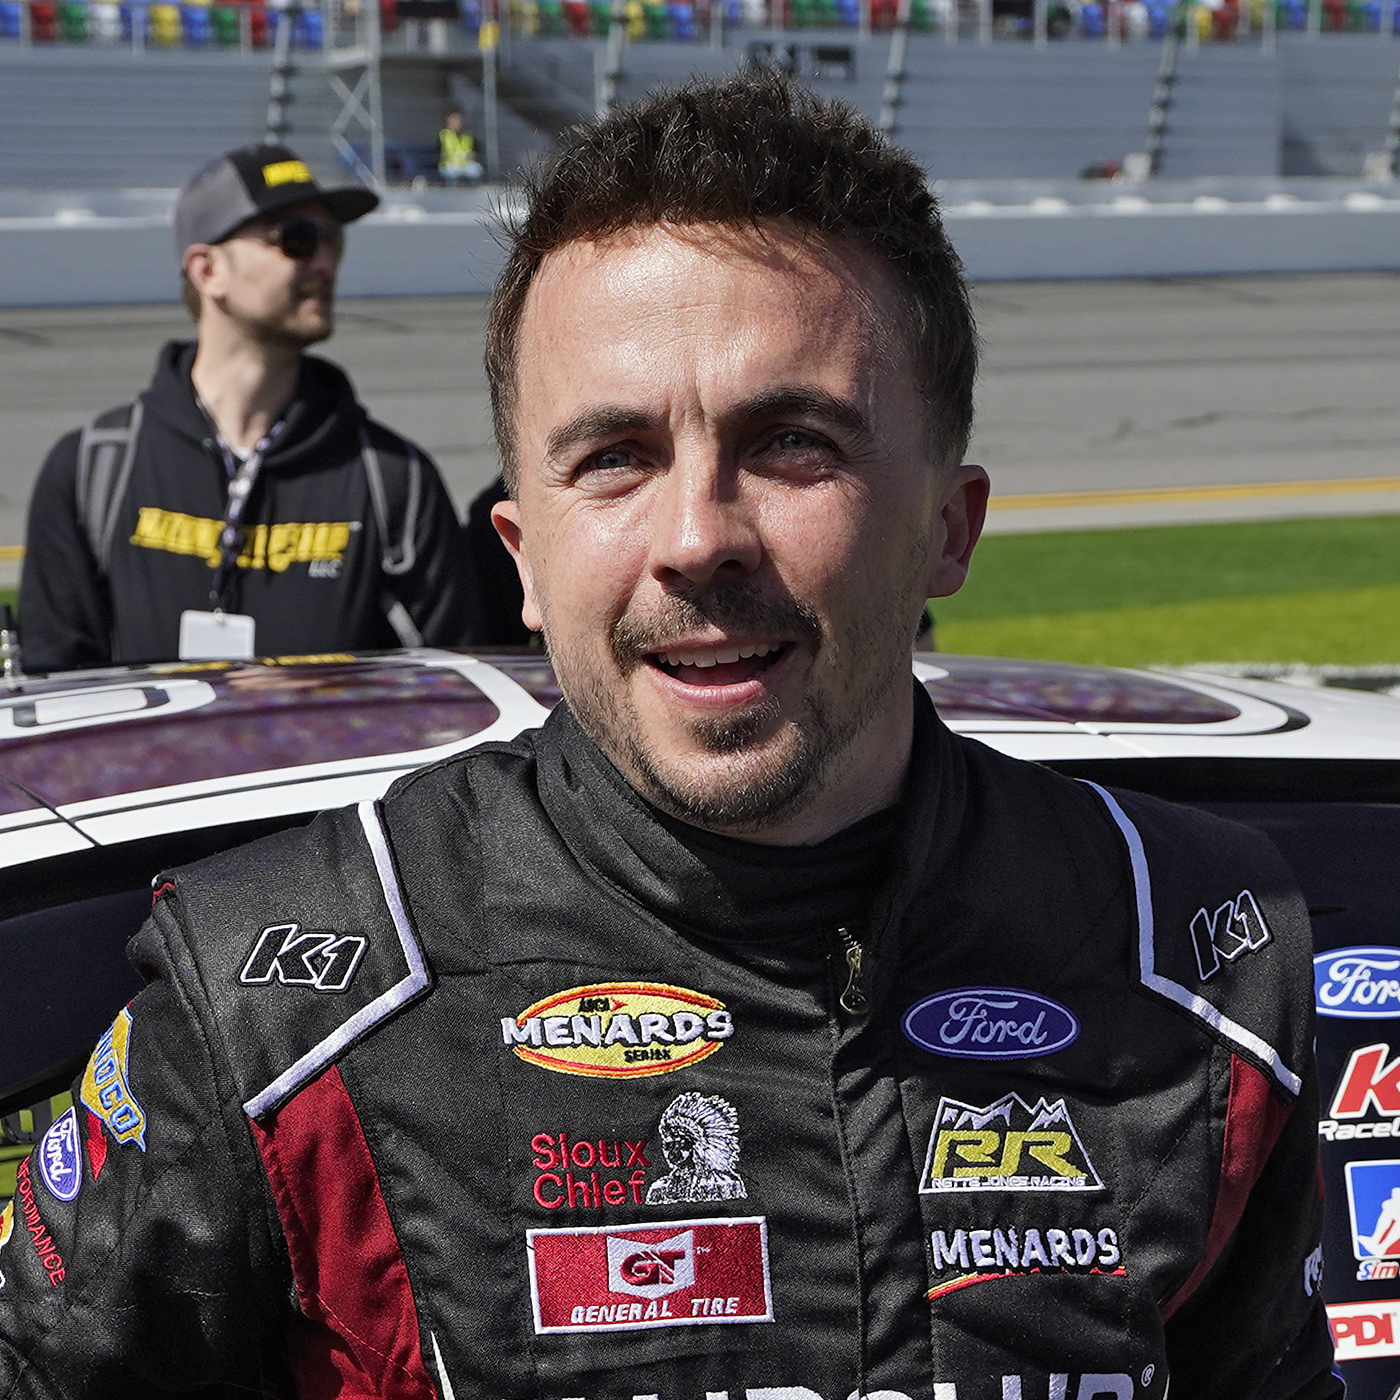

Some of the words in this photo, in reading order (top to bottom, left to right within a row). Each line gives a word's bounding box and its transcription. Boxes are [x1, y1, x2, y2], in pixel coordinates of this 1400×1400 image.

[1190, 890, 1272, 981] K1
[241, 922, 367, 991] K1
[501, 1011, 734, 1046] MENARDS
[939, 999, 1048, 1046] Ford
[47, 1118, 72, 1182] Ford
[530, 1133, 651, 1170] Sioux
[533, 1171, 646, 1208] Chief
[620, 1249, 685, 1286] GT
[932, 1228, 1120, 1270] MENARDS
[1357, 1259, 1398, 1280] Sim
[571, 1299, 672, 1324] GENERAL
[690, 1297, 740, 1316] TIRE
[1331, 1314, 1394, 1348] PDI
